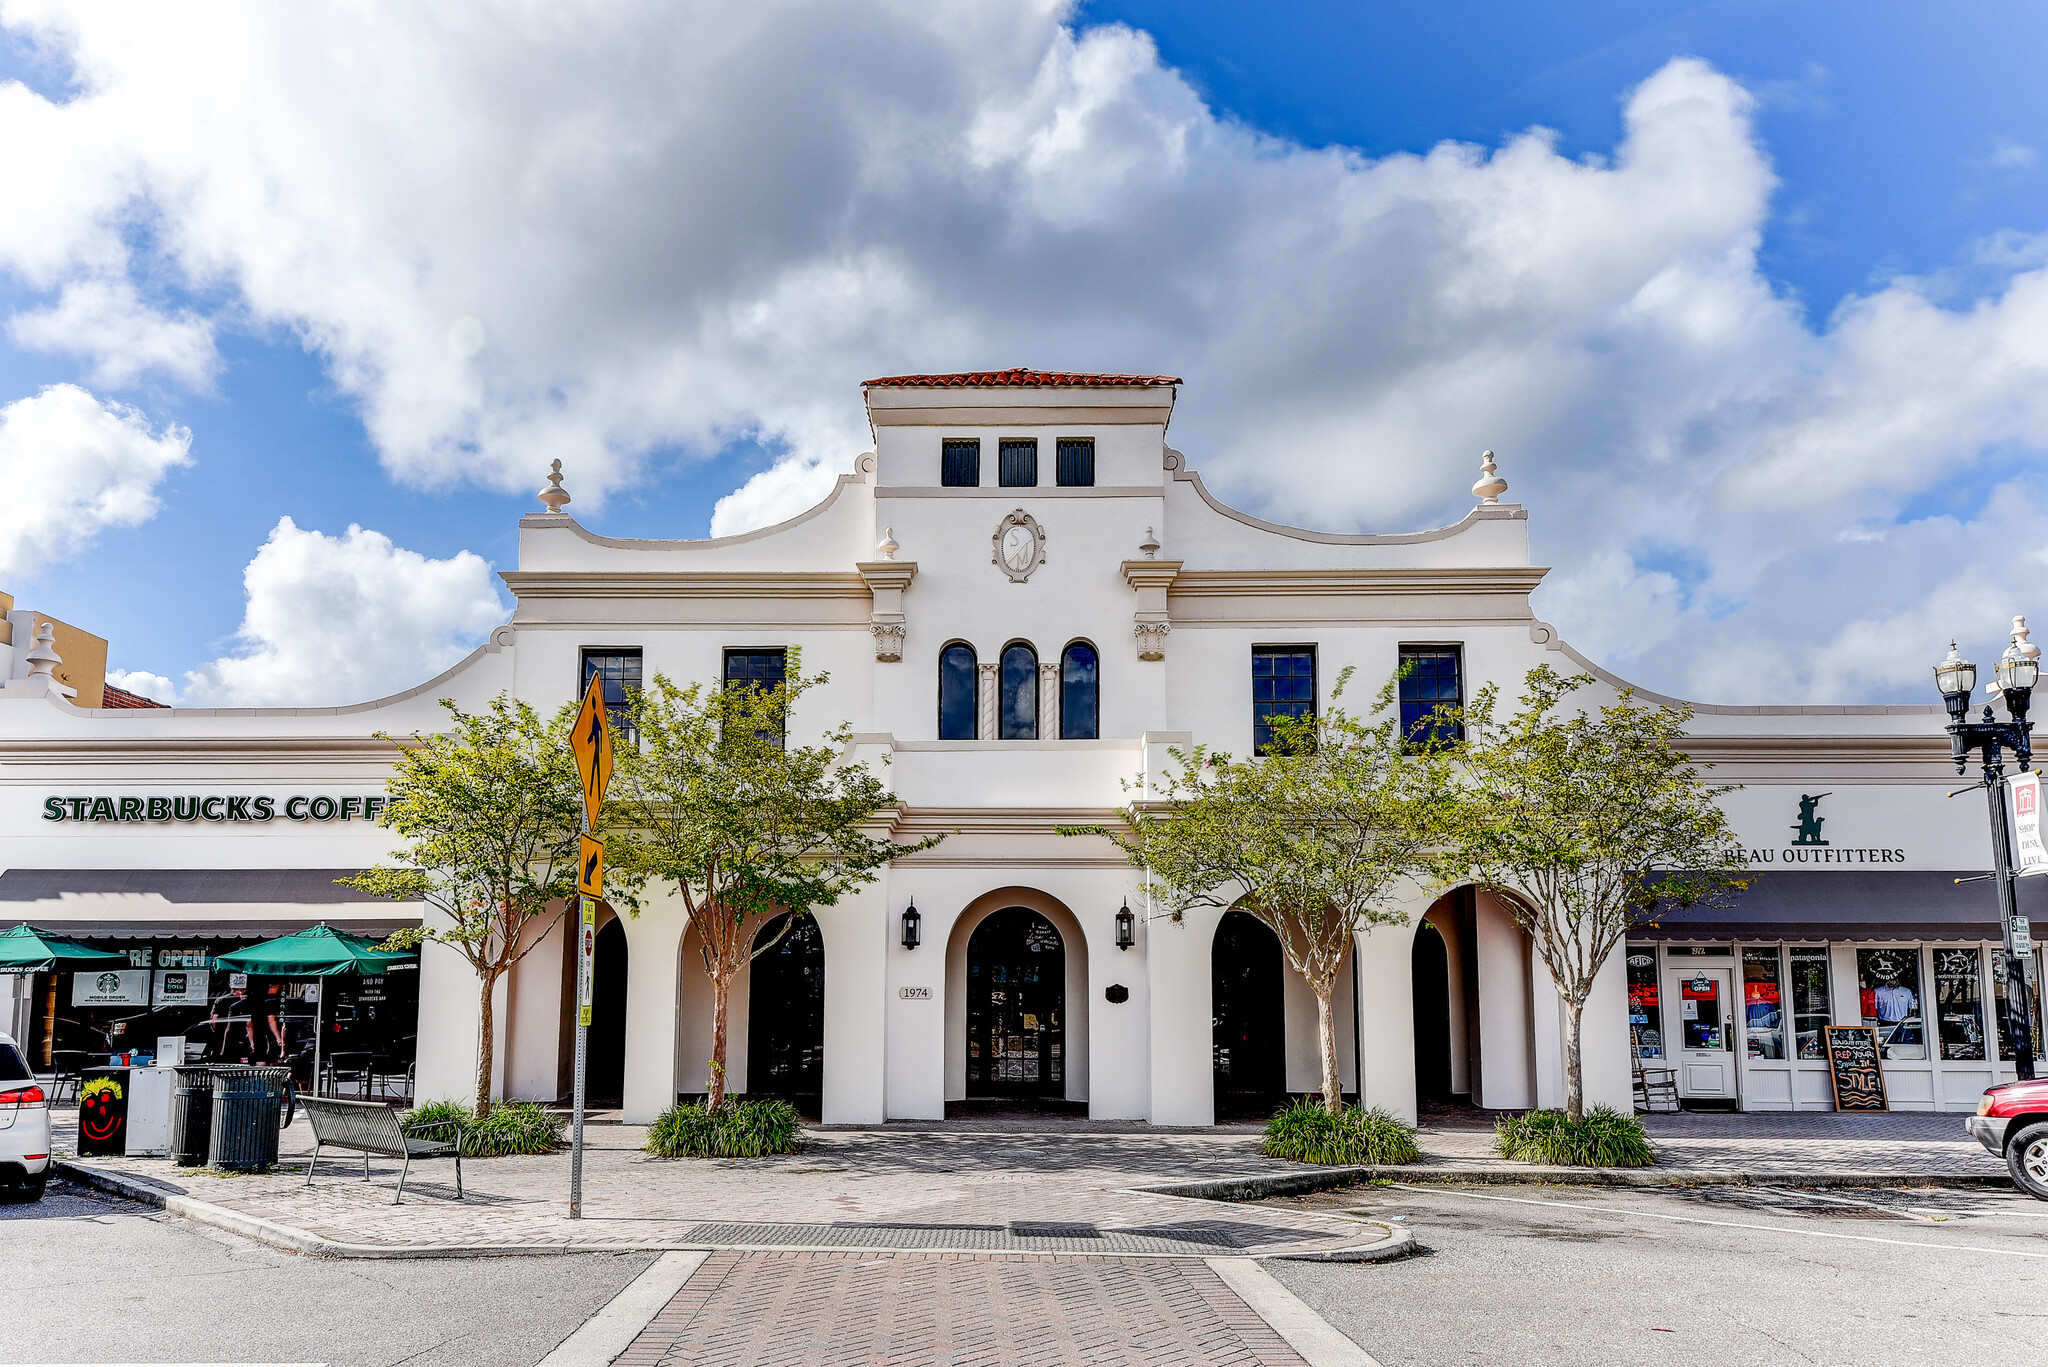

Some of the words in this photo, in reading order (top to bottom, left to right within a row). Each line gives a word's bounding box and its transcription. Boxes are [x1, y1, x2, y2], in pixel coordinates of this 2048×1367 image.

[42, 795, 275, 822] STARBUCKS
[284, 795, 406, 822] COFF
[2019, 824, 2035, 833] SHOP
[2022, 839, 2039, 849] DINE
[1725, 849, 1774, 863] BEAU
[1782, 849, 1905, 863] OUTFITTERS
[2024, 855, 2042, 865] LIVE
[2012, 919, 2017, 930] 3
[158, 949, 206, 967] OPEN
[1629, 955, 1651, 966] AFTCO
[1790, 954, 1827, 962] patagonia
[1876, 972, 1898, 980] UNDER
[904, 988, 928, 998] 1974
[1839, 1073, 1881, 1091] STYLE!
